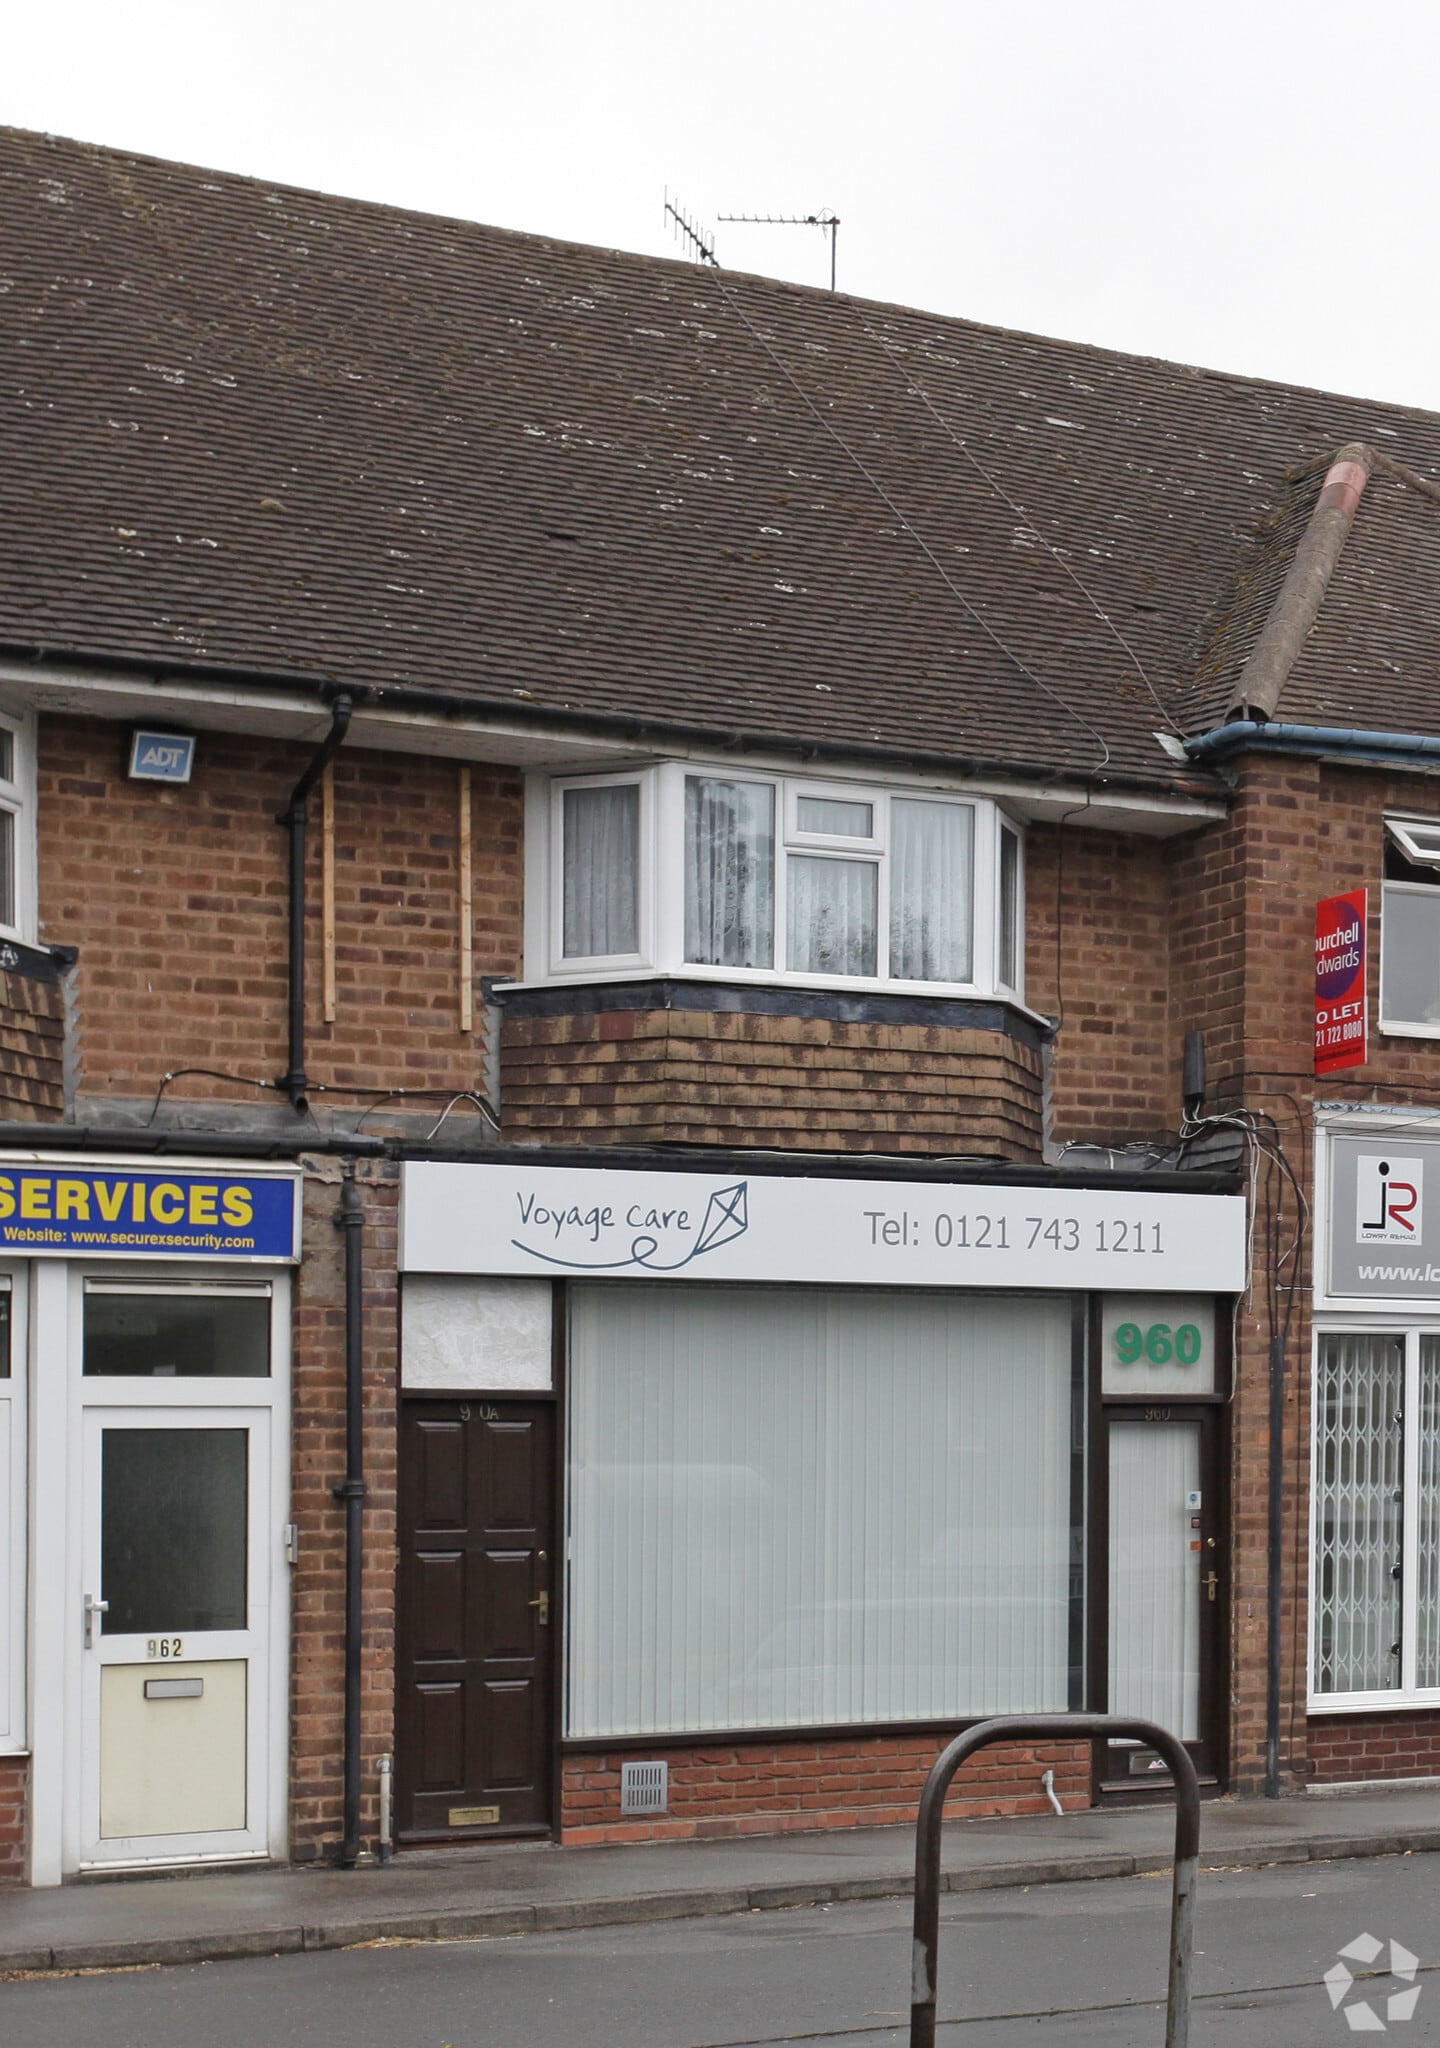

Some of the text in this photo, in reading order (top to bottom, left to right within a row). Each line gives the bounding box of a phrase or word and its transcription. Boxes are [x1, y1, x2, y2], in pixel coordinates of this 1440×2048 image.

[141, 746, 184, 769] ADT
[1332, 1002, 1362, 1021] LET
[1327, 1025, 1342, 1045] 722
[516, 1191, 616, 1242] Voyage
[3, 1226, 255, 1250] Website: www.securexsecurity.com
[863, 1211, 1165, 1254] Tel: 0121 743 1211
[1115, 1322, 1202, 1365] 960
[1144, 1407, 1171, 1421] 960
[147, 1638, 182, 1658] 962
